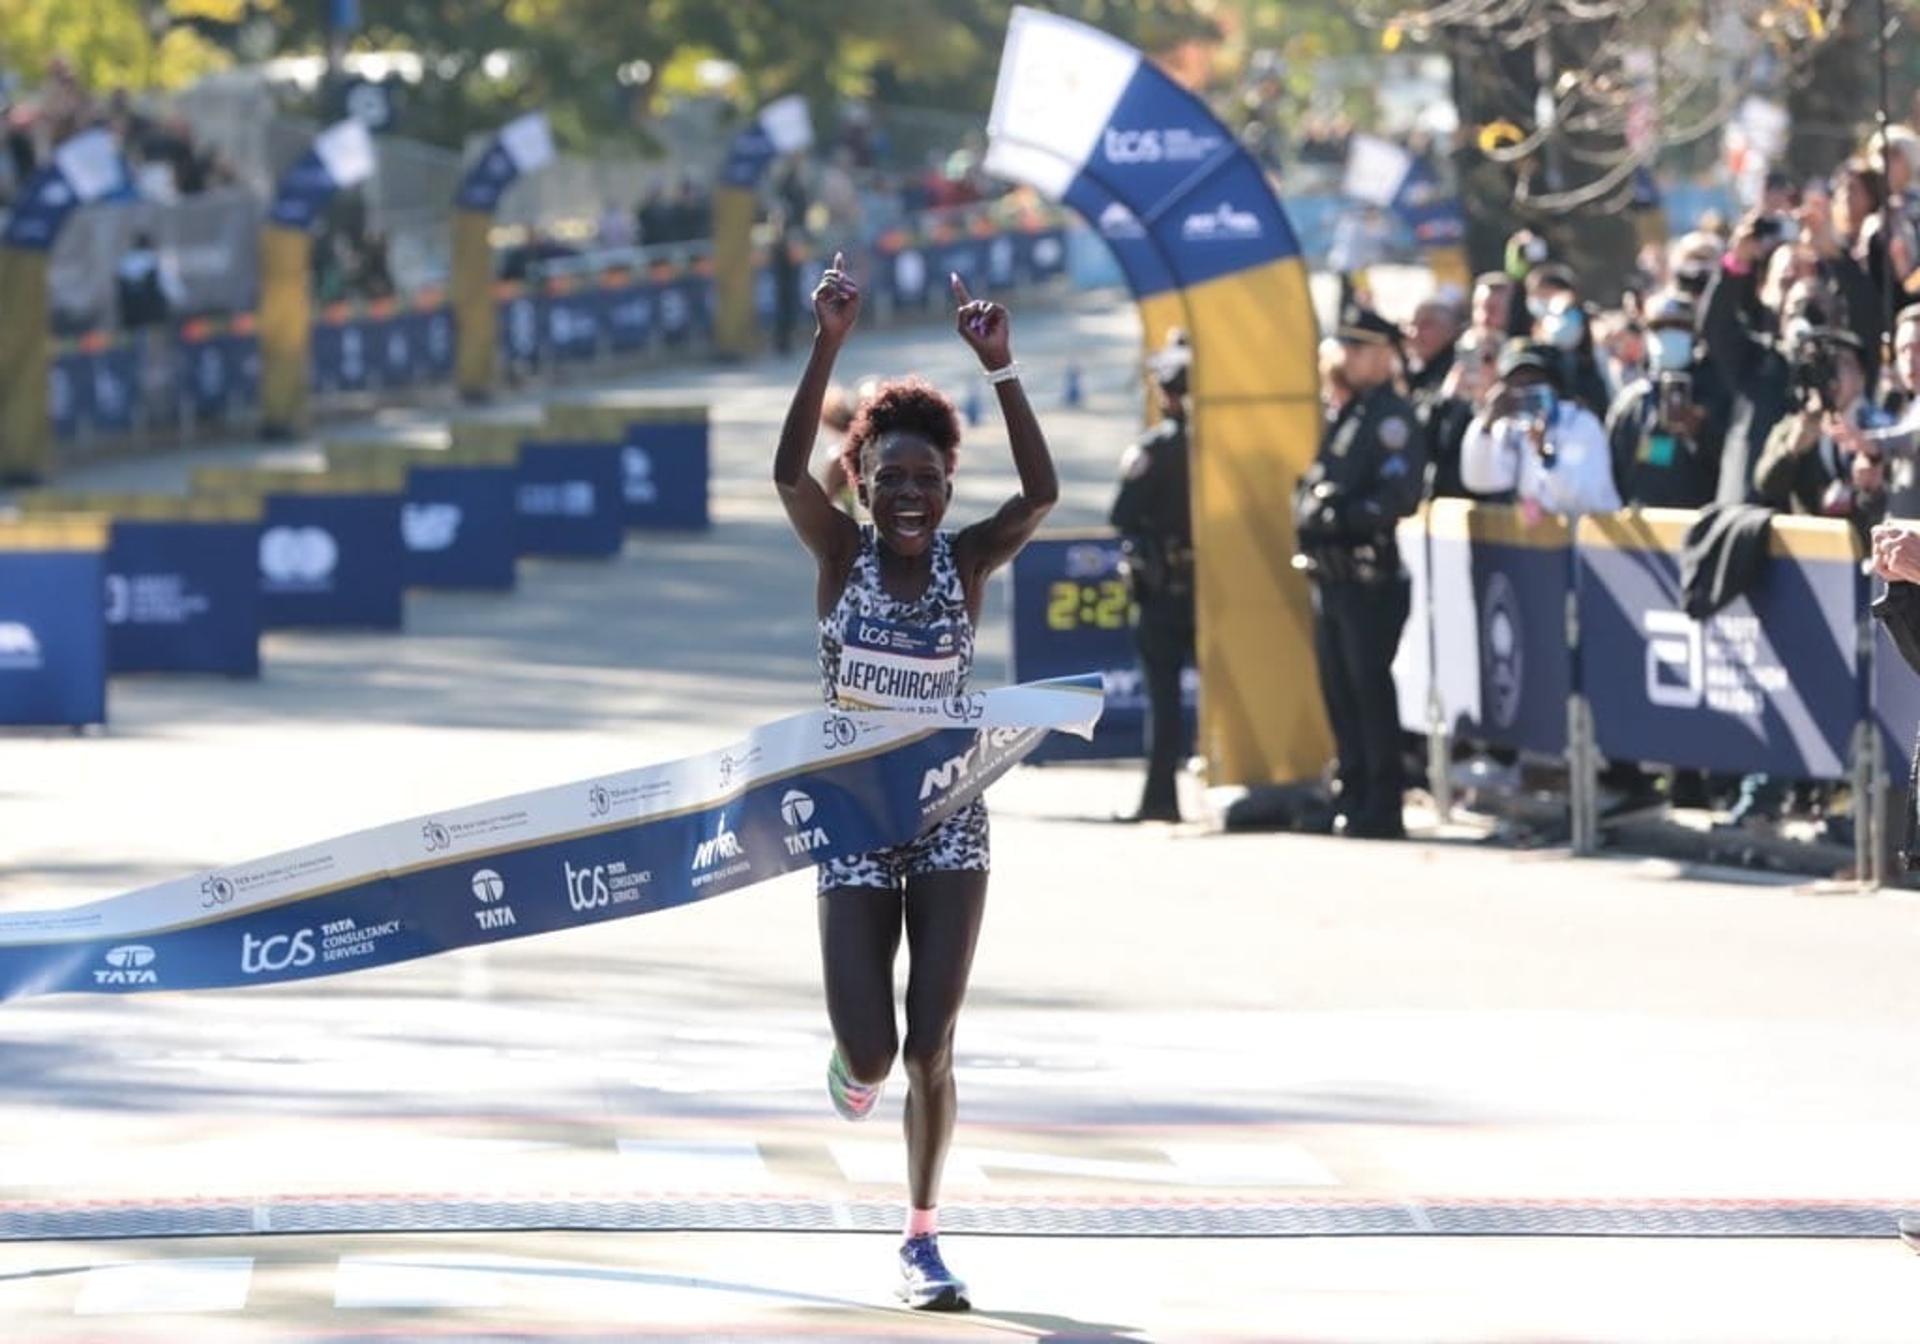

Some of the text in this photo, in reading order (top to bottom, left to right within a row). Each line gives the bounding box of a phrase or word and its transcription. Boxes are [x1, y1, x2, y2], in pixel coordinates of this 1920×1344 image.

[1047, 580, 1141, 630] 2:2
[784, 827, 830, 855] TATA
[564, 860, 608, 912] tcs
[321, 917, 356, 936] TATA
[475, 906, 516, 930] TATA
[322, 919, 400, 949] CONSULTANCY
[241, 928, 316, 974] tcs
[323, 940, 376, 962] SERVICES
[92, 969, 158, 984] TATA
